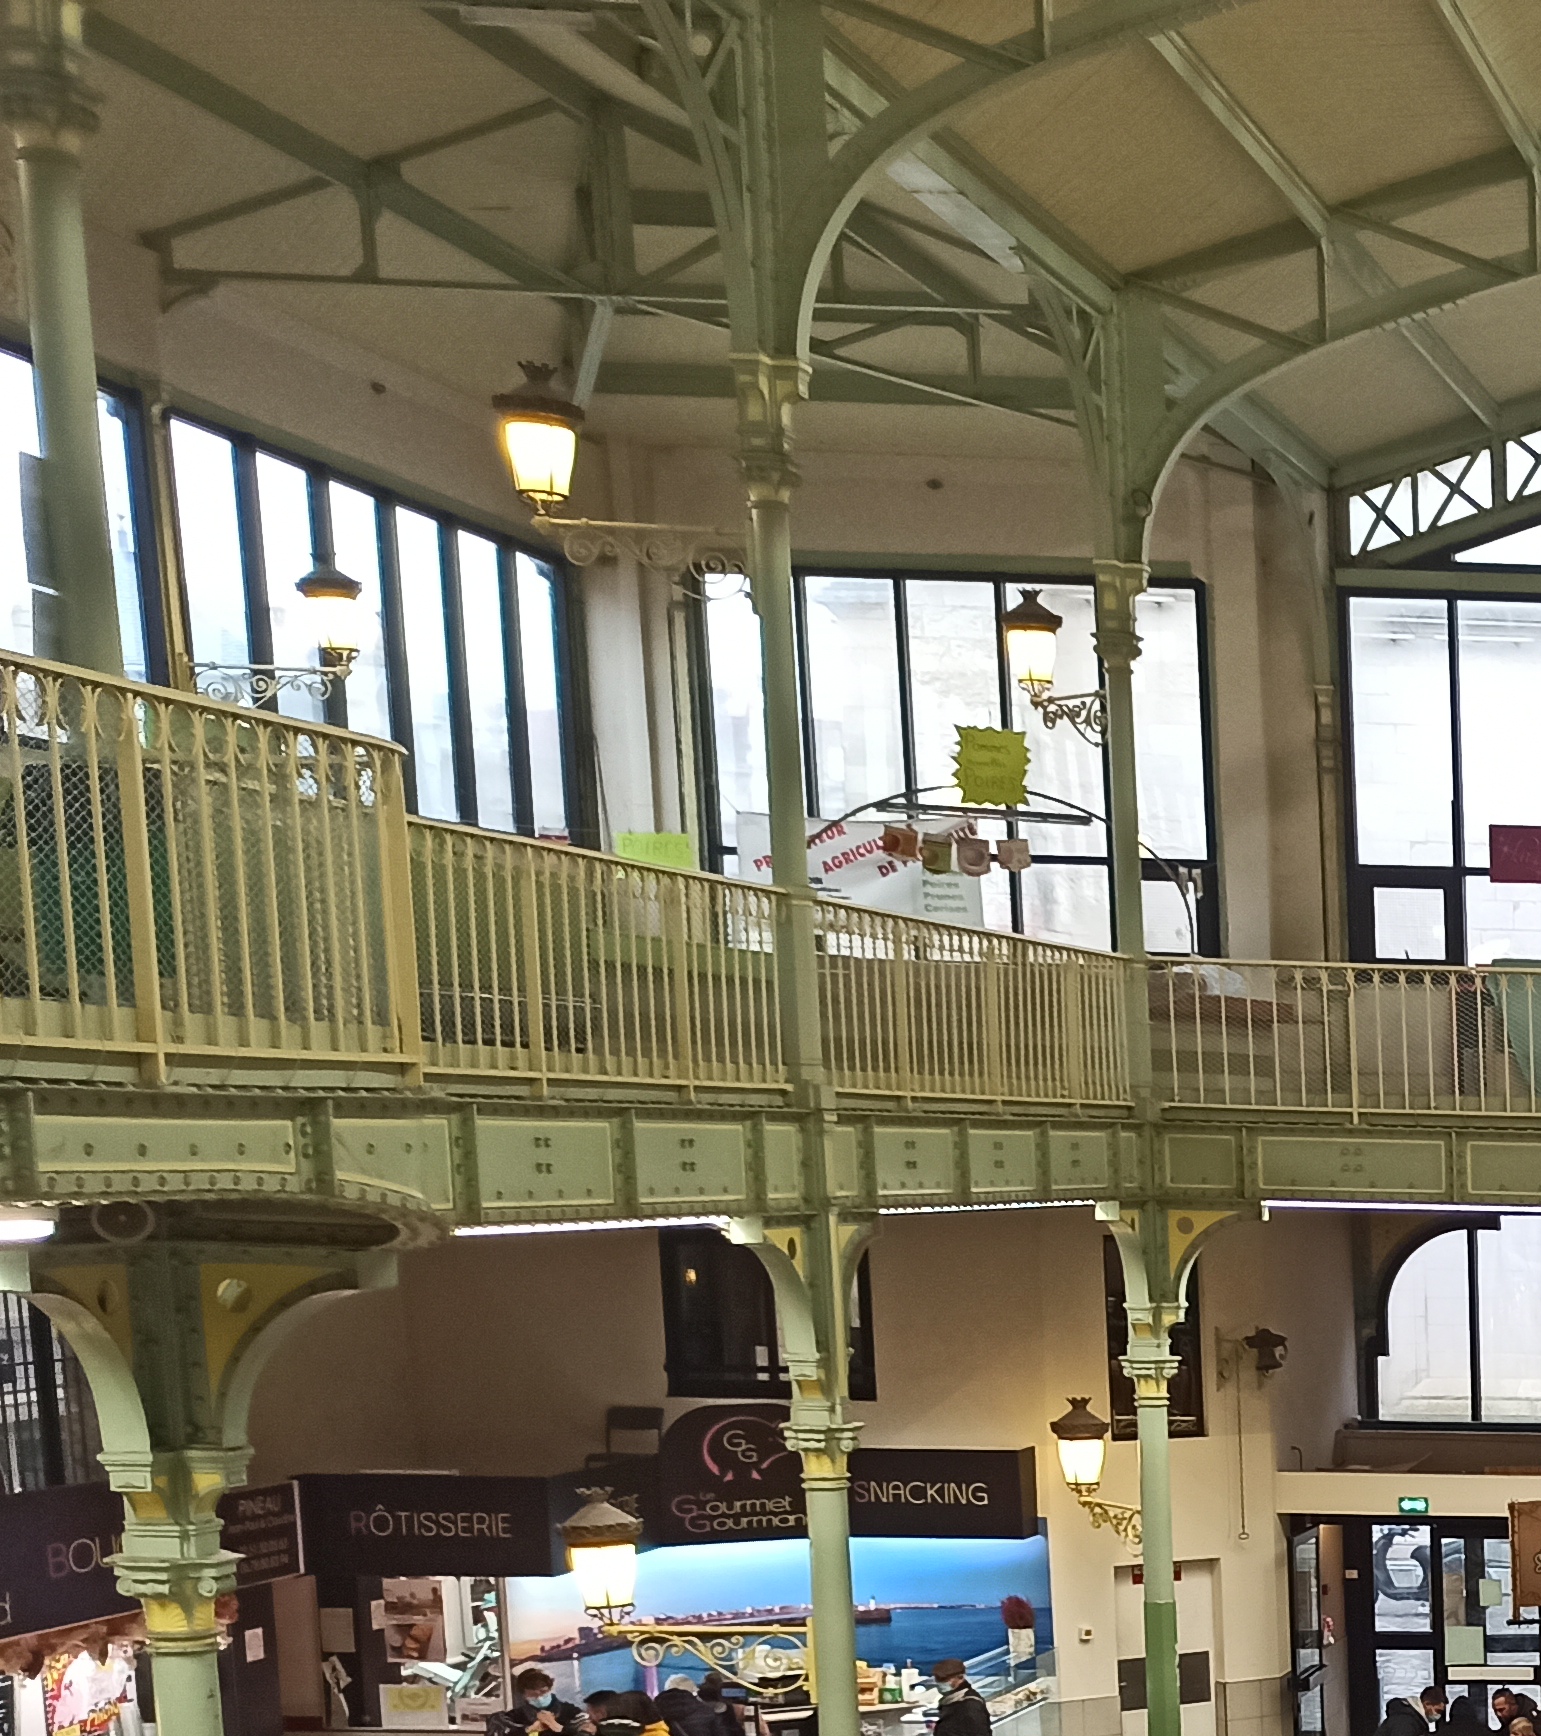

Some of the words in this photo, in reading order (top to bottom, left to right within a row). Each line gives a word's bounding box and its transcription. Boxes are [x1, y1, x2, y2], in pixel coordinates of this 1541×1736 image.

[672, 1494, 793, 1518] Gourmet
[853, 1480, 988, 1507] SNACKING
[349, 1505, 513, 1540] RÔTISSERIE
[685, 1511, 806, 1533] Gourman
